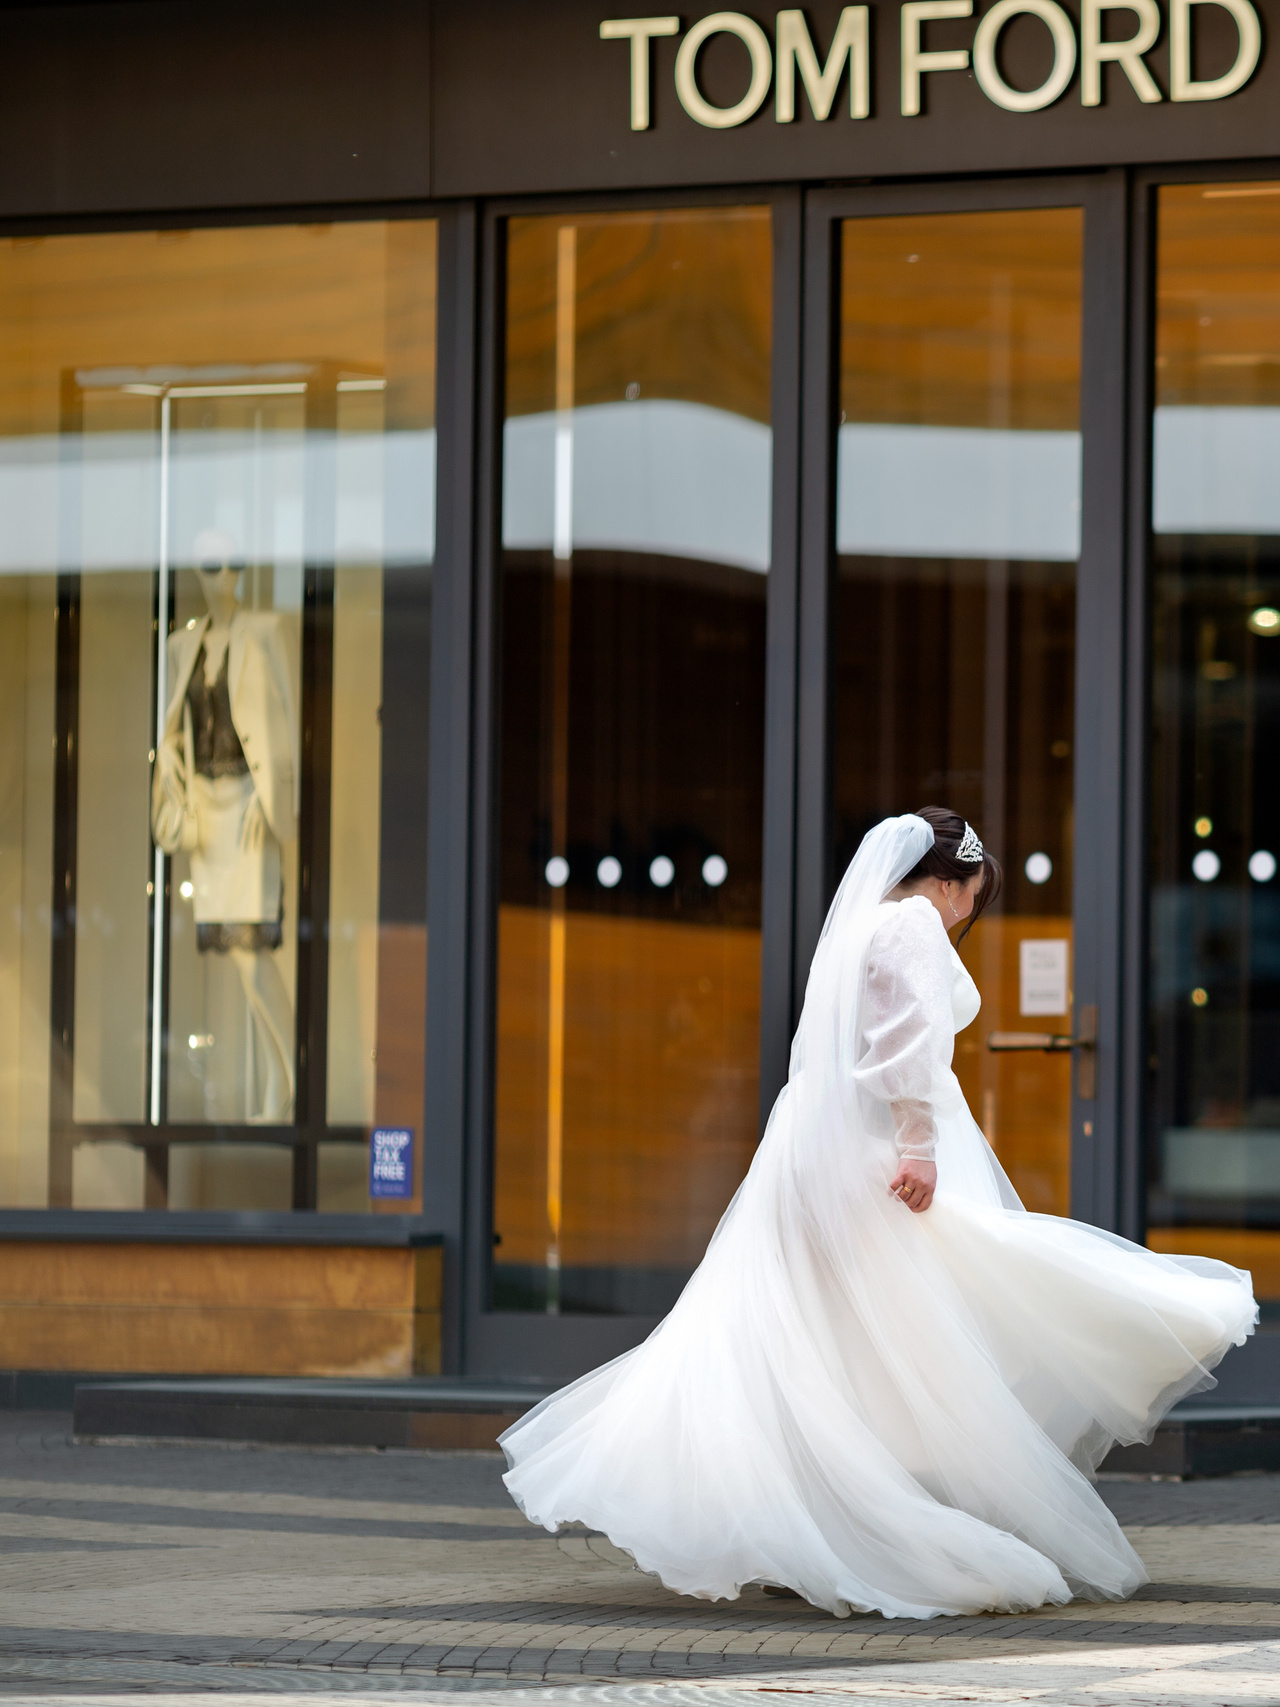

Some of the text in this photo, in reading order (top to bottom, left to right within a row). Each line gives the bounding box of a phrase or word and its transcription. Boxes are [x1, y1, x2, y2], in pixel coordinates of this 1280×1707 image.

[600, 0, 1262, 131] TOM FORD
[374, 1130, 410, 1149] SHOP
[374, 1147, 401, 1162] TAX
[373, 1161, 406, 1181] FREE
